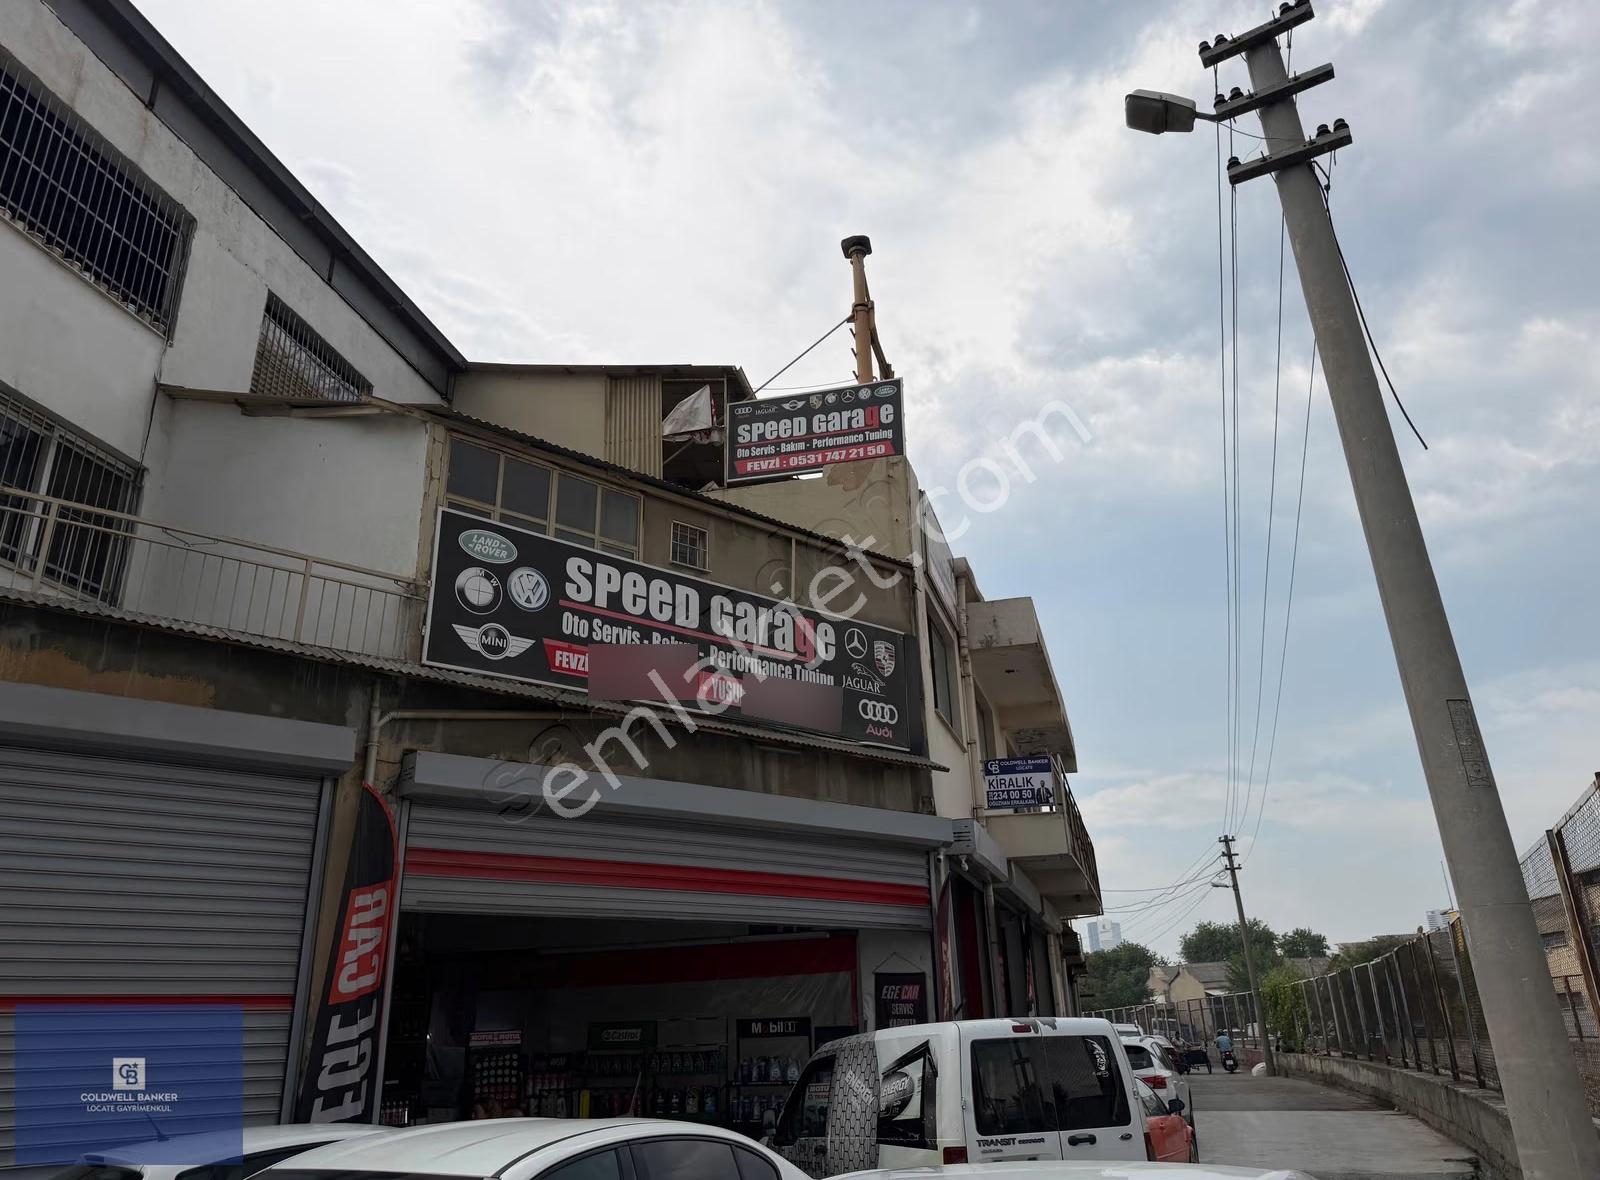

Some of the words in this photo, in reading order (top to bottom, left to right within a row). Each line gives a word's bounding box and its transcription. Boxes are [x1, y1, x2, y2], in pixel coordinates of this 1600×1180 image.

[736, 448, 750, 459] Oto
[750, 444, 775, 457] Servis
[812, 433, 864, 448] Performance
[865, 428, 893, 441] Tuning
[746, 457, 780, 472] FEVZİ
[789, 452, 823, 467] 0531
[825, 450, 846, 460] 747
[848, 446, 864, 457] 21
[867, 444, 886, 456] 50
[472, 534, 500, 548] LAND
[474, 544, 508, 559] ROVER
[562, 611, 589, 638] Oto
[592, 618, 641, 645] Servis
[481, 635, 507, 648] MINI
[709, 645, 792, 680] Performance
[842, 675, 881, 694] JAGUAR
[866, 723, 893, 738] Audi
[988, 776, 1034, 790] KİRALIK
[993, 791, 1008, 800] 234
[1010, 790, 1019, 799] 00
[1022, 790, 1032, 799] 50
[337, 887, 388, 995] CAR
[881, 985, 901, 1000] EGE
[901, 984, 921, 1000] CAR
[751, 1021, 784, 1034] Mobil
[845, 1069, 876, 1106] ENERGY
[976, 1138, 1017, 1147] TRANSIT
